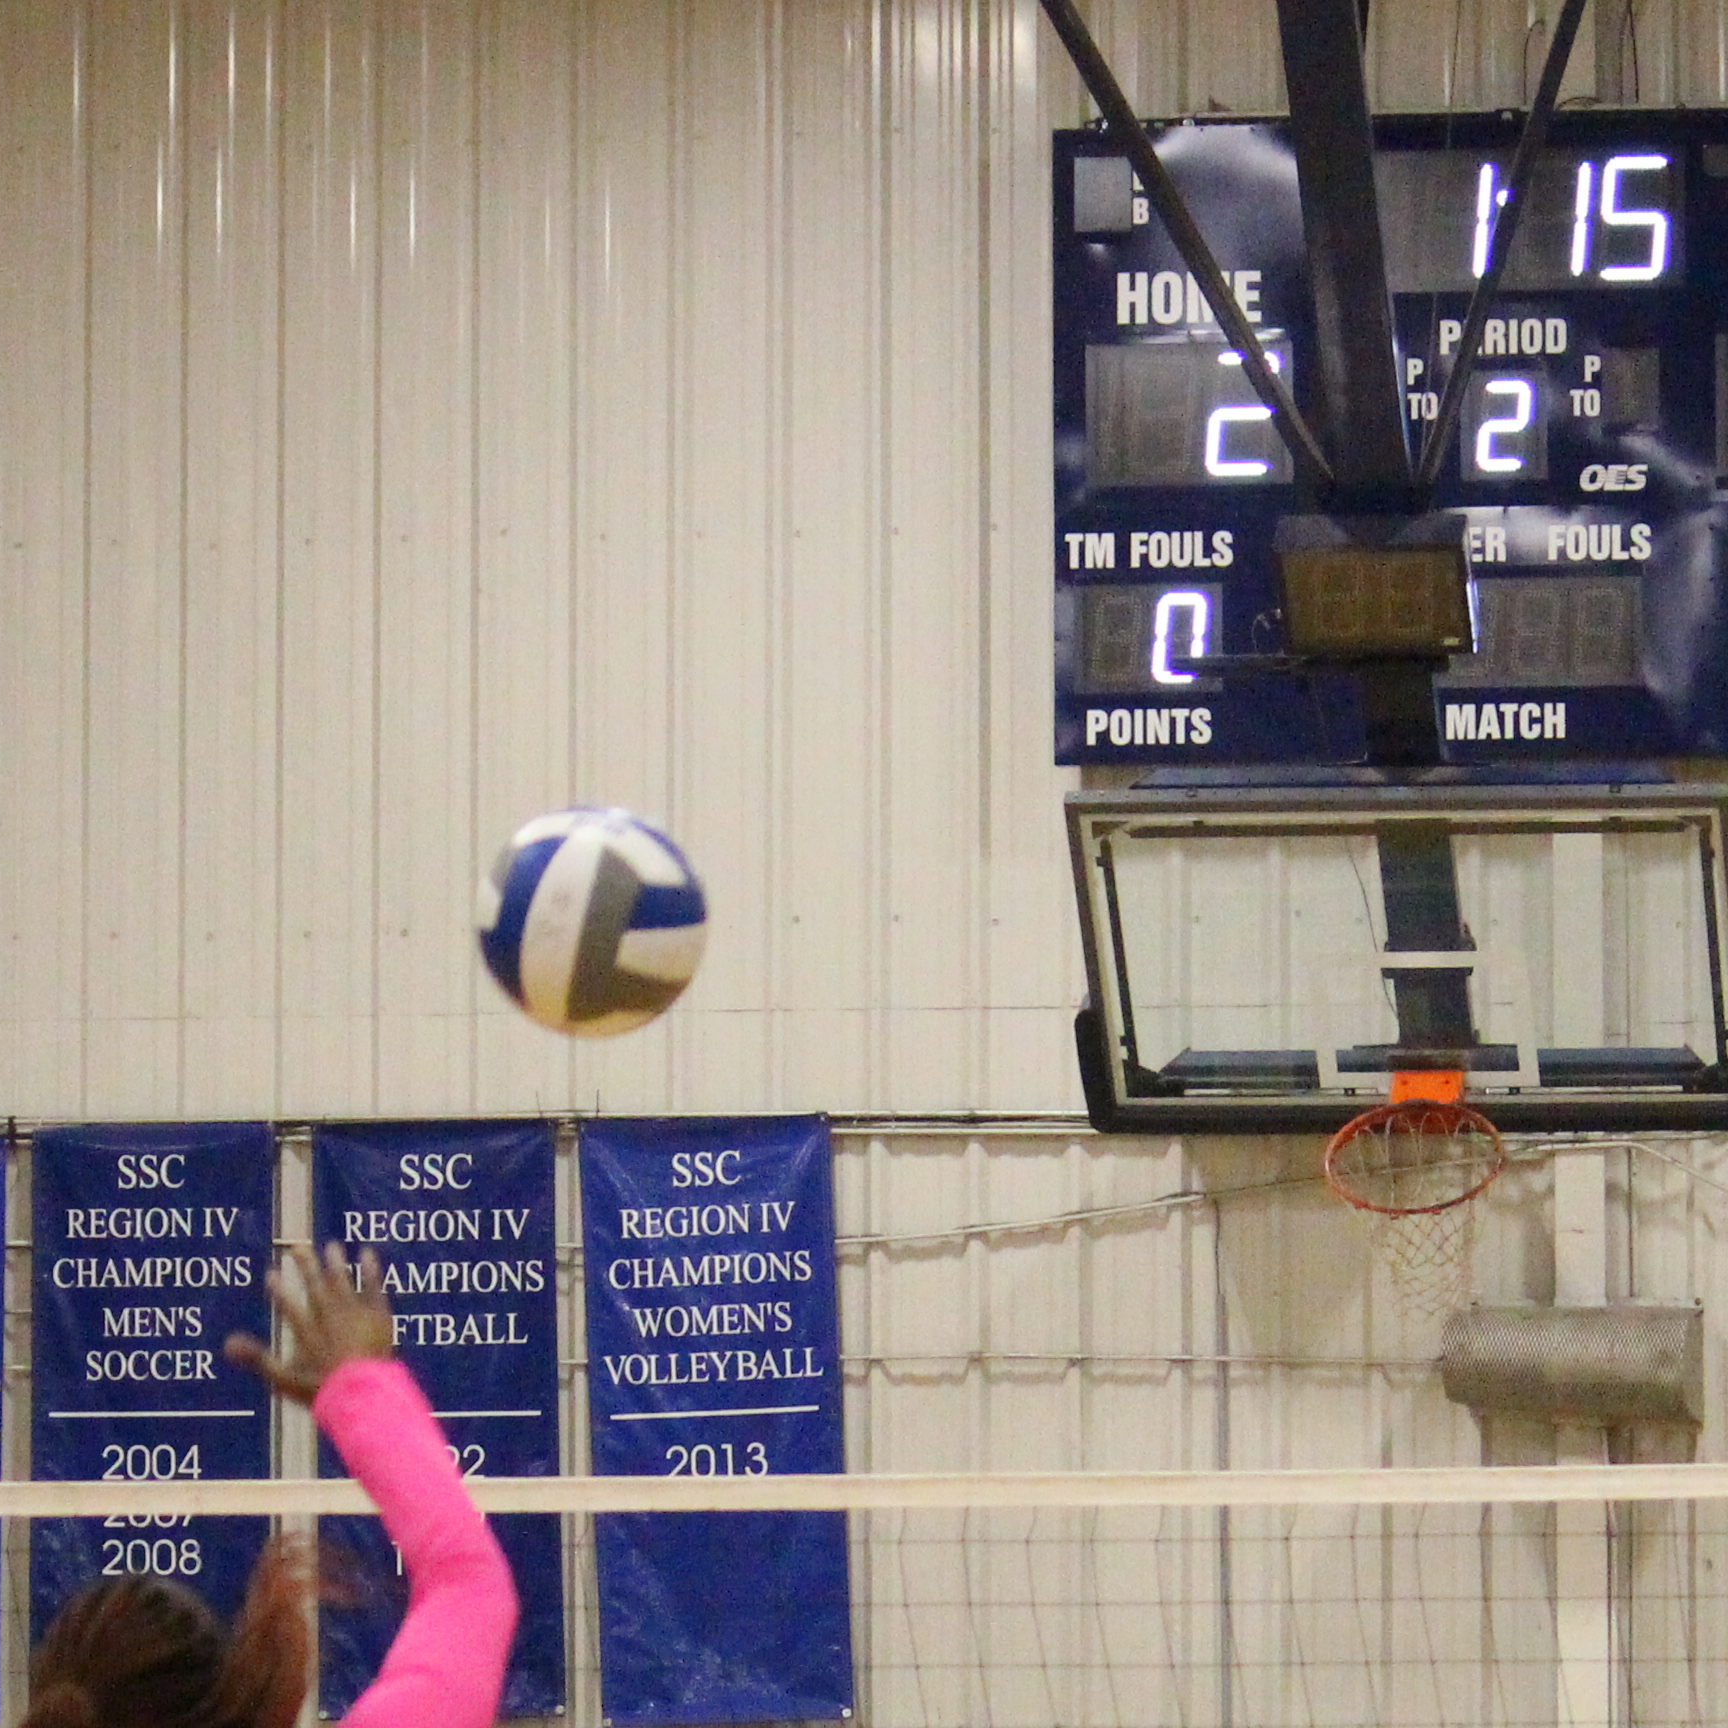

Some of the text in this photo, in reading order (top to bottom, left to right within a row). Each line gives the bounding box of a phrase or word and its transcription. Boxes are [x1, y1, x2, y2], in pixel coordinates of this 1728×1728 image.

[1133, 198, 1149, 225] B
[1440, 318, 1567, 356] PRIOD
[1407, 358, 1424, 385] P
[1584, 355, 1601, 382] P
[1407, 392, 1438, 420] TO
[1569, 389, 1600, 417] TO
[1476, 380, 1533, 472] 2
[1579, 464, 1648, 491] OES
[1065, 531, 1233, 569] TM FOULS
[1469, 523, 1652, 562] ER FOULS
[1152, 592, 1208, 683] 0
[1086, 708, 1212, 745] POINTS
[1445, 703, 1566, 740] MATCH
[117, 1155, 185, 1189] SSC
[400, 1154, 473, 1190] SSC
[672, 1151, 741, 1186] SSC
[66, 1207, 239, 1238] REGION IV
[344, 1209, 530, 1242] REGION IV
[621, 1202, 795, 1239] REGION IV
[53, 1257, 252, 1288] CHAMPIONS
[345, 1260, 545, 1294] AMPIONS
[608, 1251, 811, 1290] CHAMPIONS
[103, 1308, 202, 1337] MEN'S
[392, 1313, 528, 1345] FTBALL
[632, 1302, 792, 1338] WOMEN'S
[86, 1350, 216, 1381] SOCCER
[604, 1347, 823, 1385] VOLLEYBALL
[102, 1444, 202, 1480] 2004
[666, 1442, 768, 1478] 2013
[102, 1539, 202, 1575] 2008
